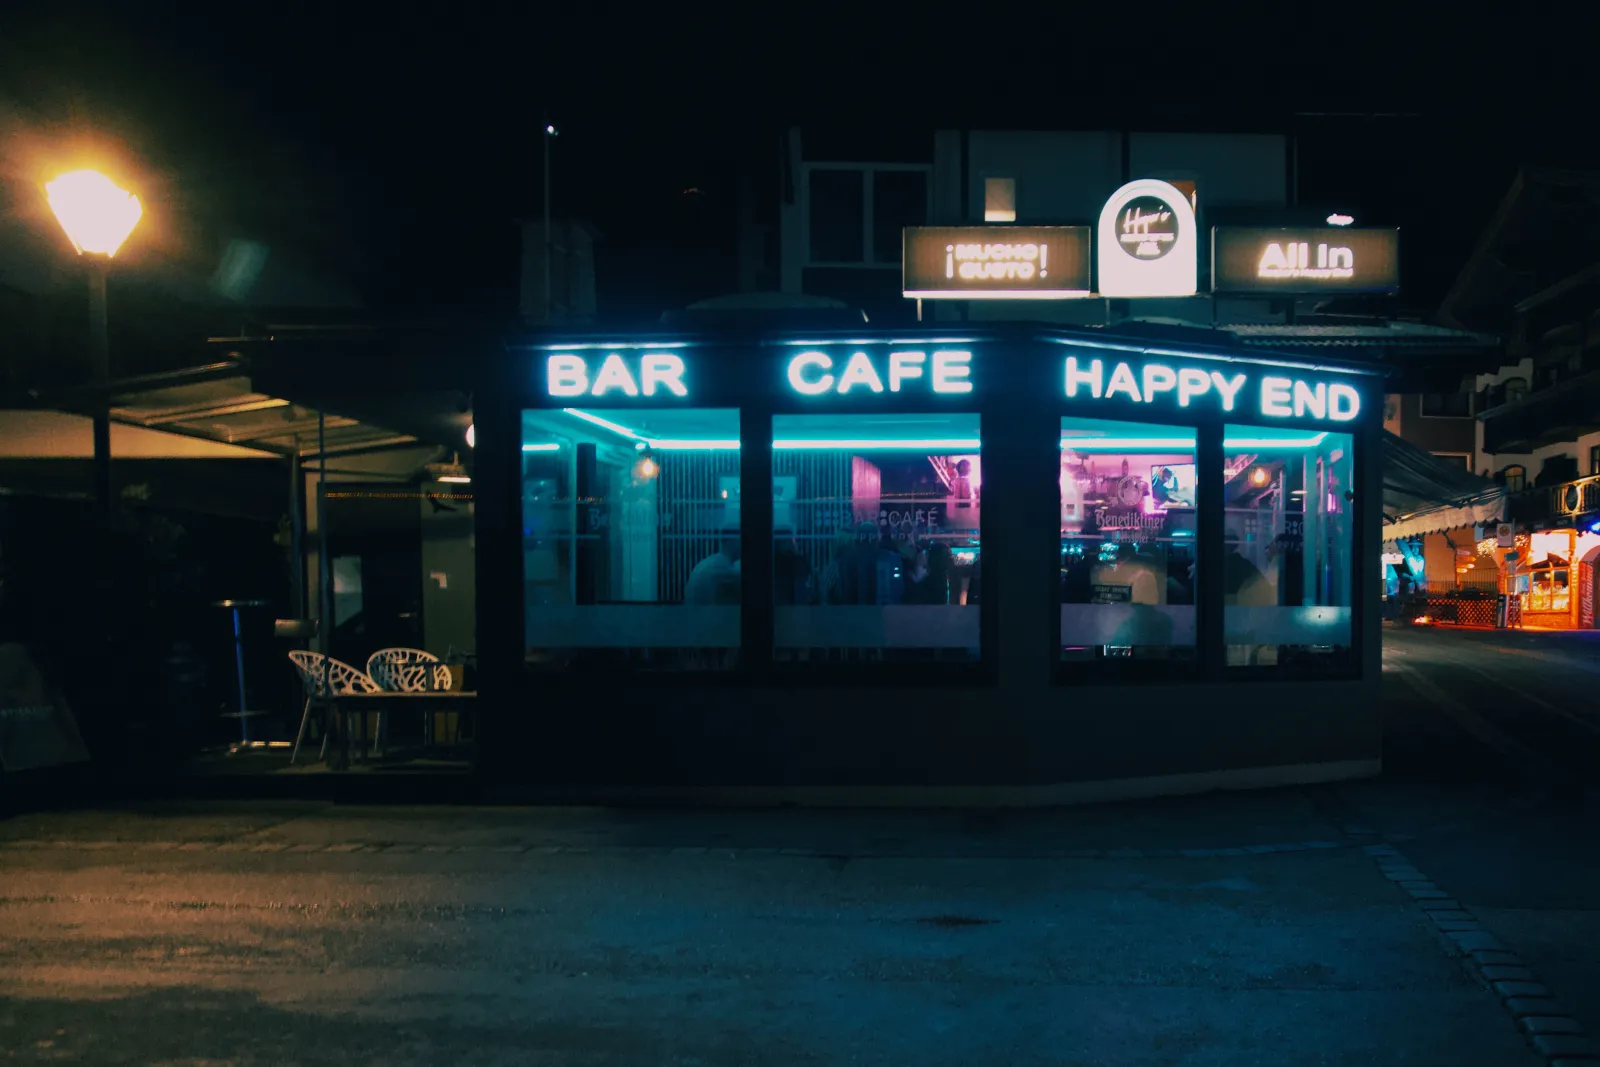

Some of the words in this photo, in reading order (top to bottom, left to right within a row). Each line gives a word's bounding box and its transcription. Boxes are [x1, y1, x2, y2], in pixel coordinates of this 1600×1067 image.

[1259, 242, 1308, 268] All
[1318, 243, 1353, 268] In
[548, 354, 687, 396] BAR
[788, 351, 972, 394] CAFE
[1065, 356, 1247, 412] HAPPY
[1261, 377, 1360, 420] END
[1094, 509, 1166, 529] Benediktiner
